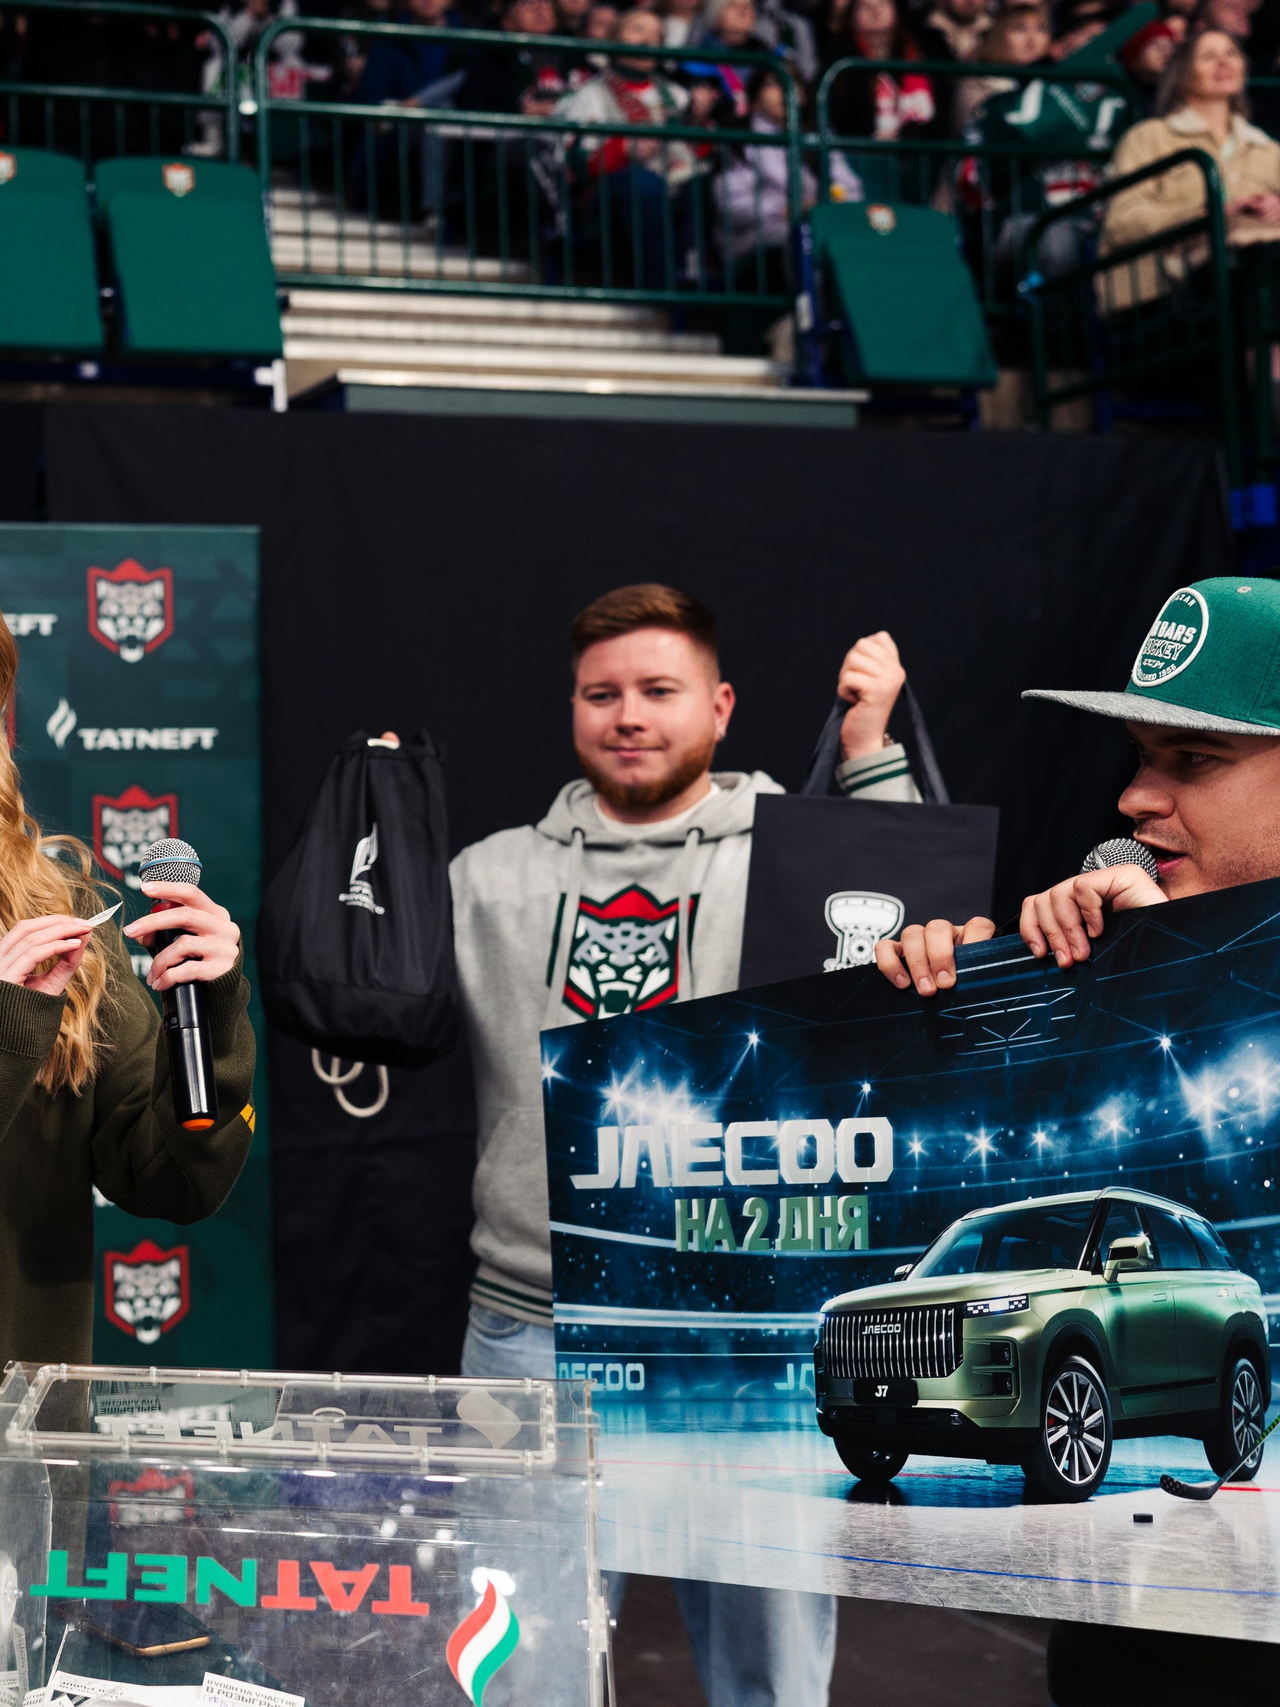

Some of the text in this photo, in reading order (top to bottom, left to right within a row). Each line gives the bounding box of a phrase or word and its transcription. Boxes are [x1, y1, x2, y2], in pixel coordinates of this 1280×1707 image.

[77, 727, 219, 750] TATNEFT
[570, 1116, 894, 1189] JAECOO
[674, 1194, 869, 1252] НА 2 ДНЯ
[862, 1323, 902, 1335] JAECOO
[558, 1362, 645, 1392] AECOO
[874, 1384, 889, 1398] J7
[30, 1550, 430, 1616] TATNEFT
[205, 1686, 214, 1694] В
[207, 1679, 298, 1707] КУПОН НА УЧАСТИЕ
